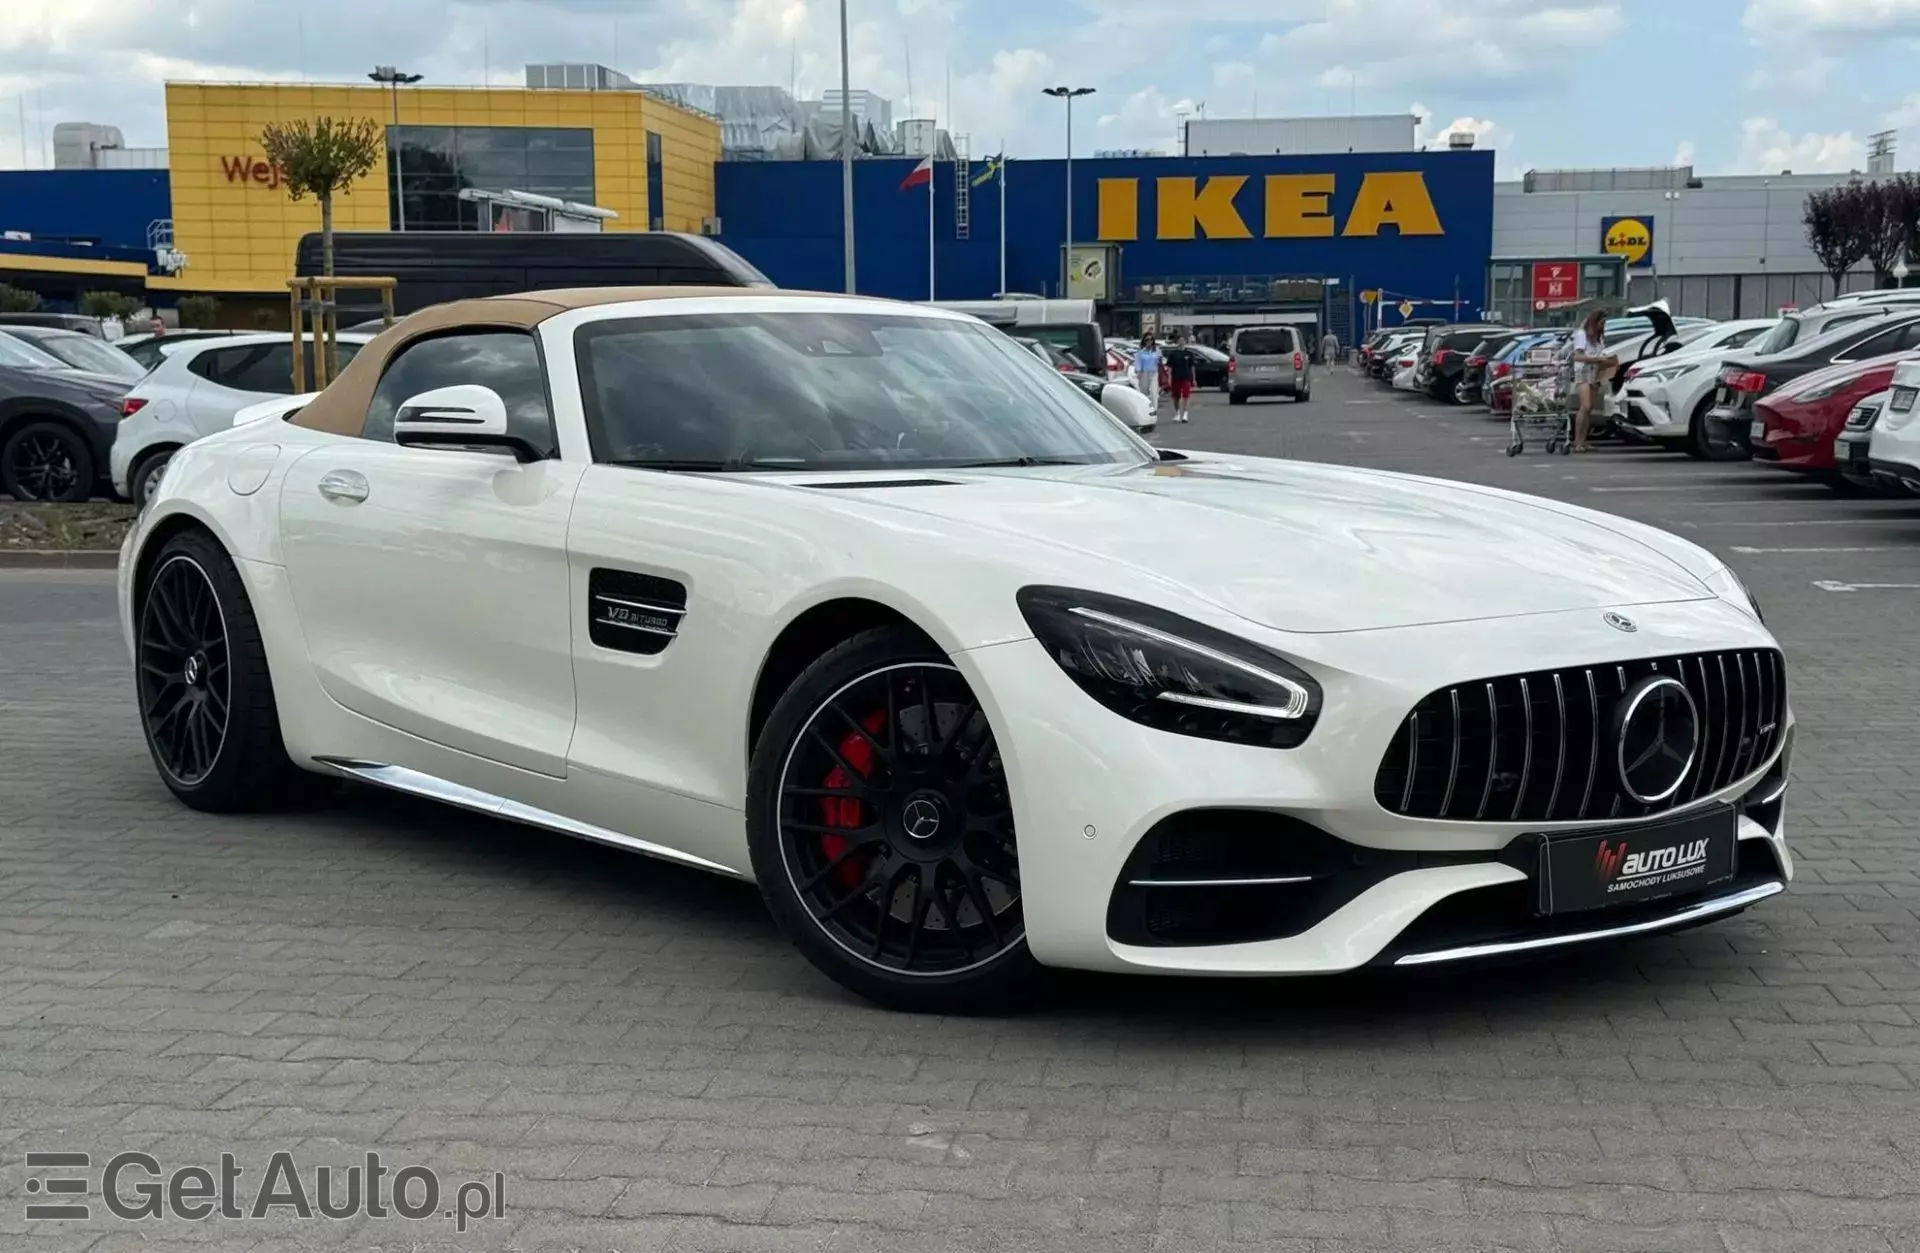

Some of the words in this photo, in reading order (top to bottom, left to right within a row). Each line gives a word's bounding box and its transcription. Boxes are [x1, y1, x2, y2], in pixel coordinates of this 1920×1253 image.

[1097, 171, 1445, 241] IKEA
[607, 606, 629, 620] V8
[1677, 838, 1709, 864] LUX
[1607, 876, 1662, 893] SAMOCHODY
[1662, 864, 1705, 882] LUKSUSOWE
